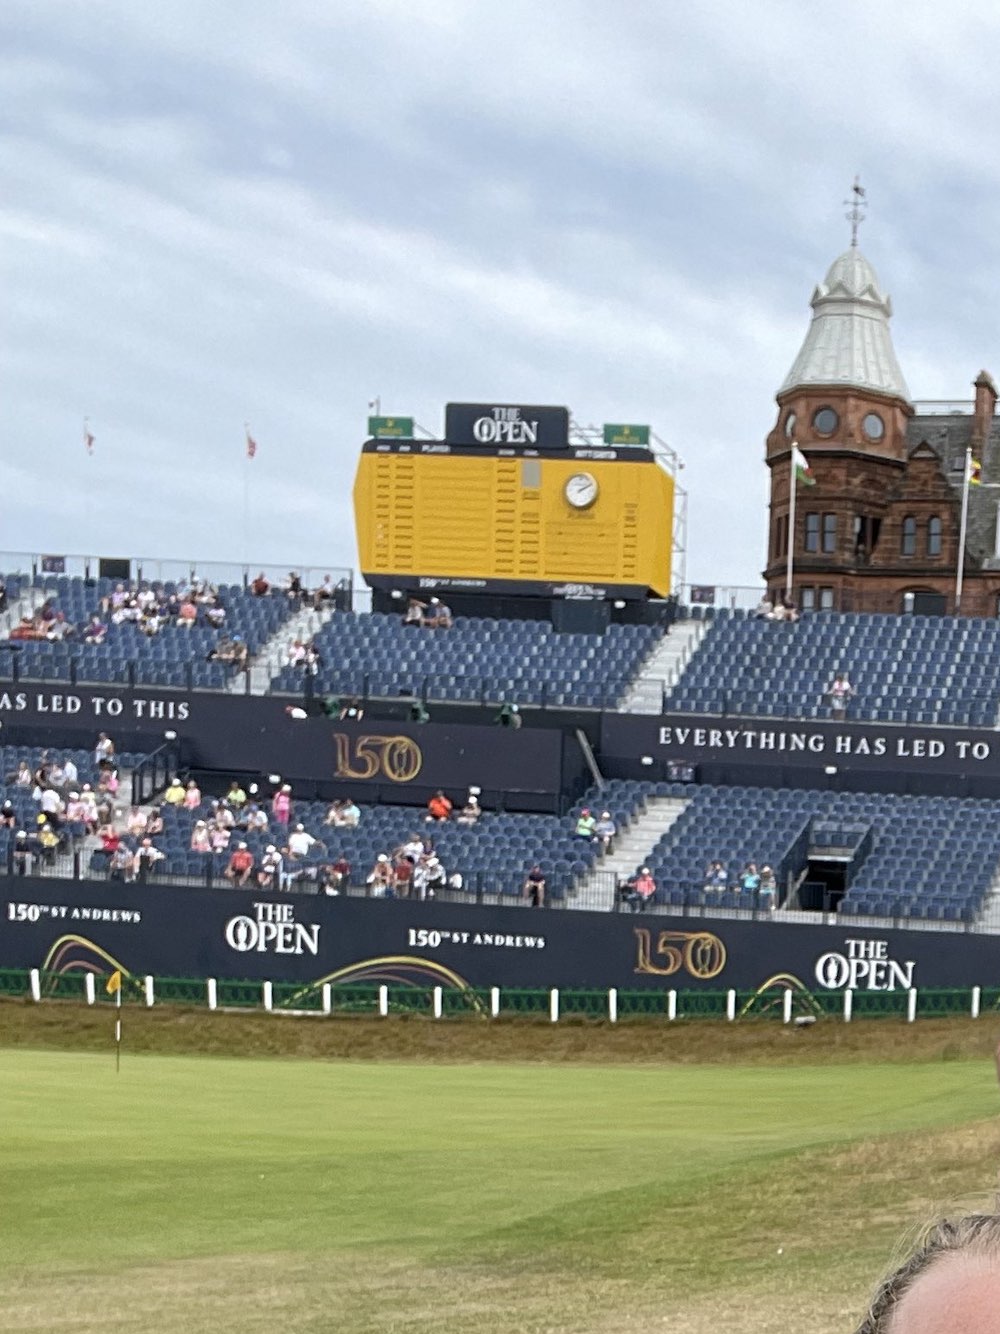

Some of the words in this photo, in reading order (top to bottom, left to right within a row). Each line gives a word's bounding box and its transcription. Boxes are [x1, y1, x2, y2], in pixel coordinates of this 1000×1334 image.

[492, 407, 521, 421] THE
[473, 417, 538, 442] OPEN
[37, 694, 82, 714] LED
[91, 697, 124, 716] TO
[133, 700, 190, 720] THIS
[659, 726, 825, 753] EVERYTHING
[836, 735, 887, 756] HAS
[897, 738, 946, 758] LED
[955, 741, 990, 760] TO
[333, 731, 422, 782] 150
[51, 906, 67, 919] ST
[71, 906, 142, 924] ANDREWS
[254, 902, 295, 923] THE
[225, 916, 321, 956] OPEN
[452, 931, 470, 944] ST
[473, 933, 546, 949] ANDREWS
[634, 927, 727, 979] 150
[845, 939, 888, 960] THE
[815, 952, 916, 991] OPEN
